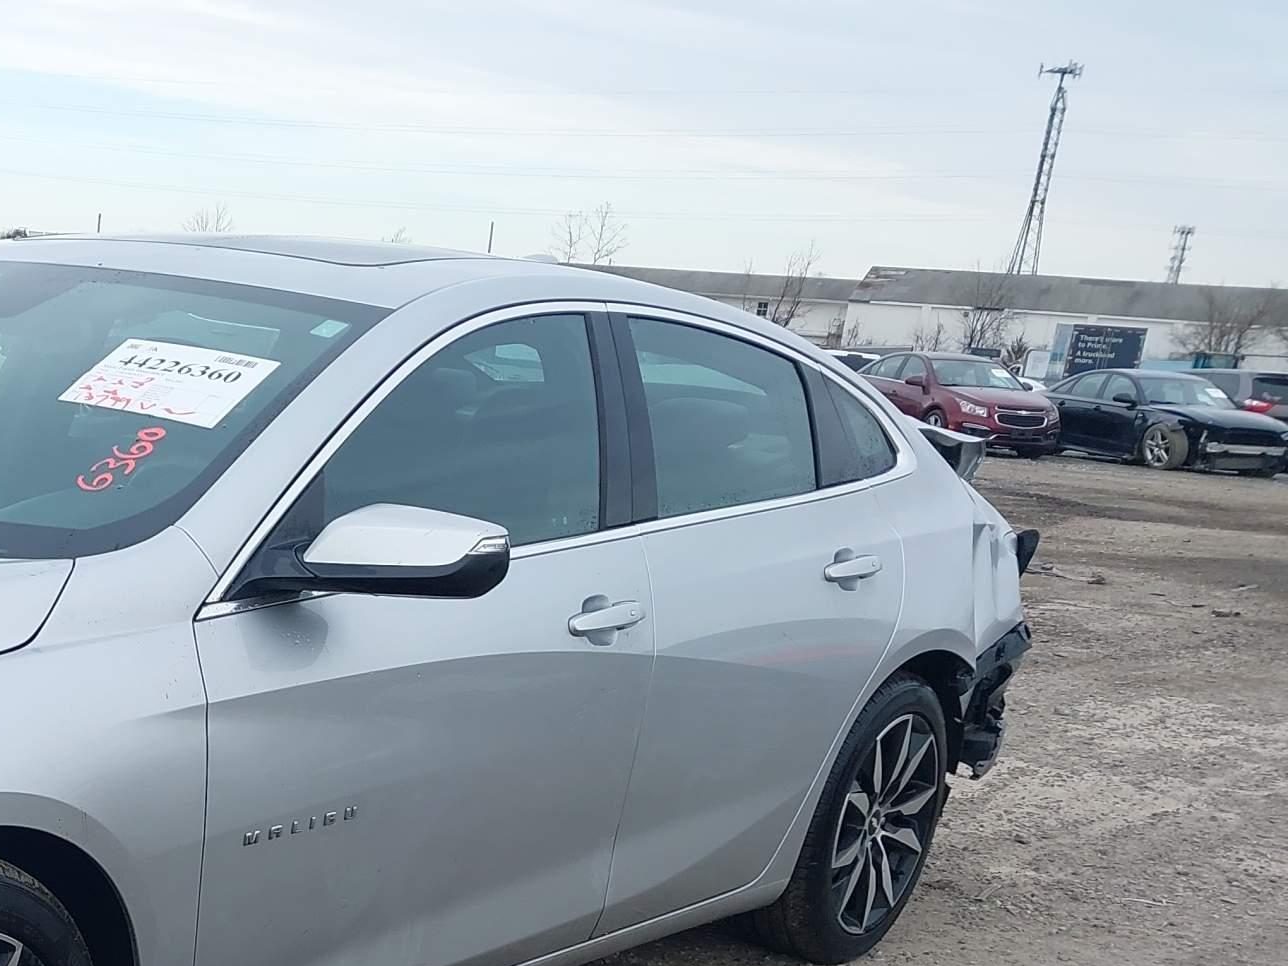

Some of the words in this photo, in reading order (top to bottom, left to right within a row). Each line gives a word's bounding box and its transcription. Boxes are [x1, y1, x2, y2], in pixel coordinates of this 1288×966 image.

[119, 354, 242, 383] 44226360
[76, 426, 167, 491] 6360
[243, 806, 358, 847] MALIBU
